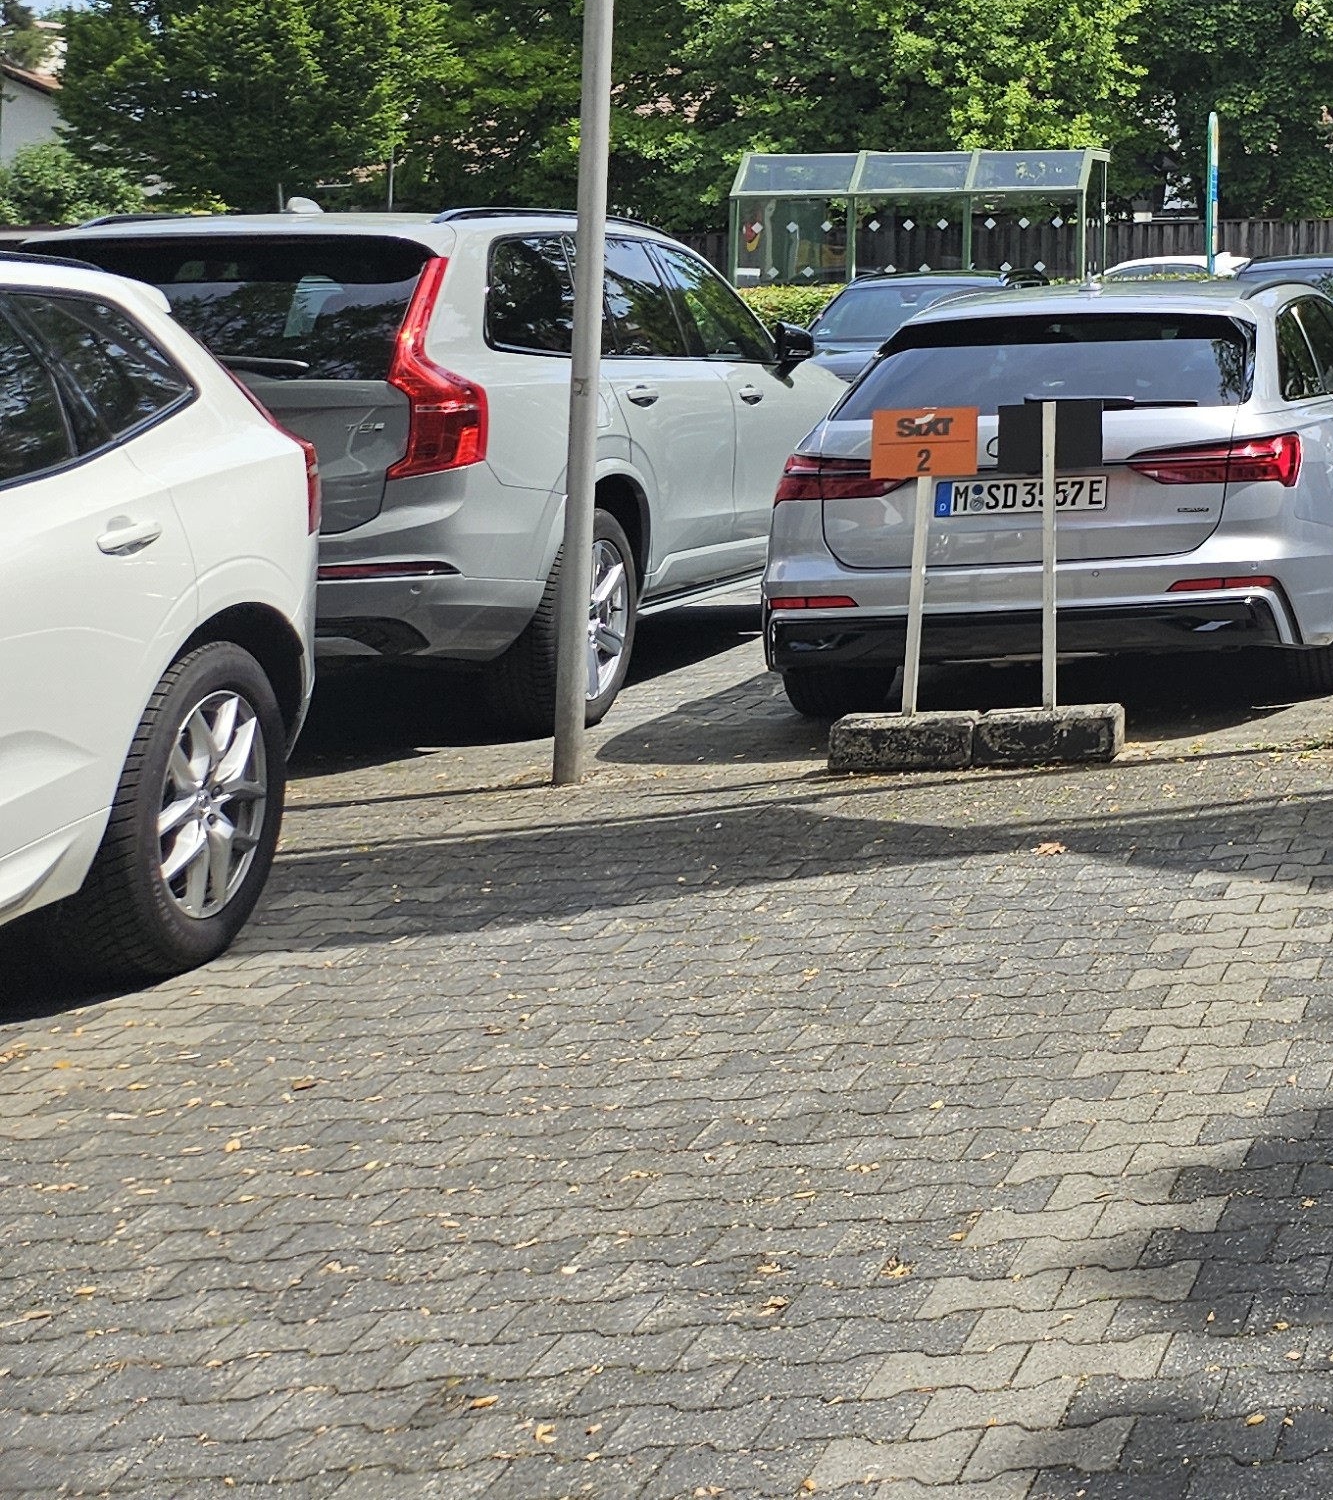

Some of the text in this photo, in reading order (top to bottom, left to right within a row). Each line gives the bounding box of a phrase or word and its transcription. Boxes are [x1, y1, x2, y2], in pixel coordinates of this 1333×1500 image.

[916, 449, 930, 472] 2
[939, 503, 947, 512] D
[953, 485, 969, 512] M
[985, 483, 1018, 510] SD
